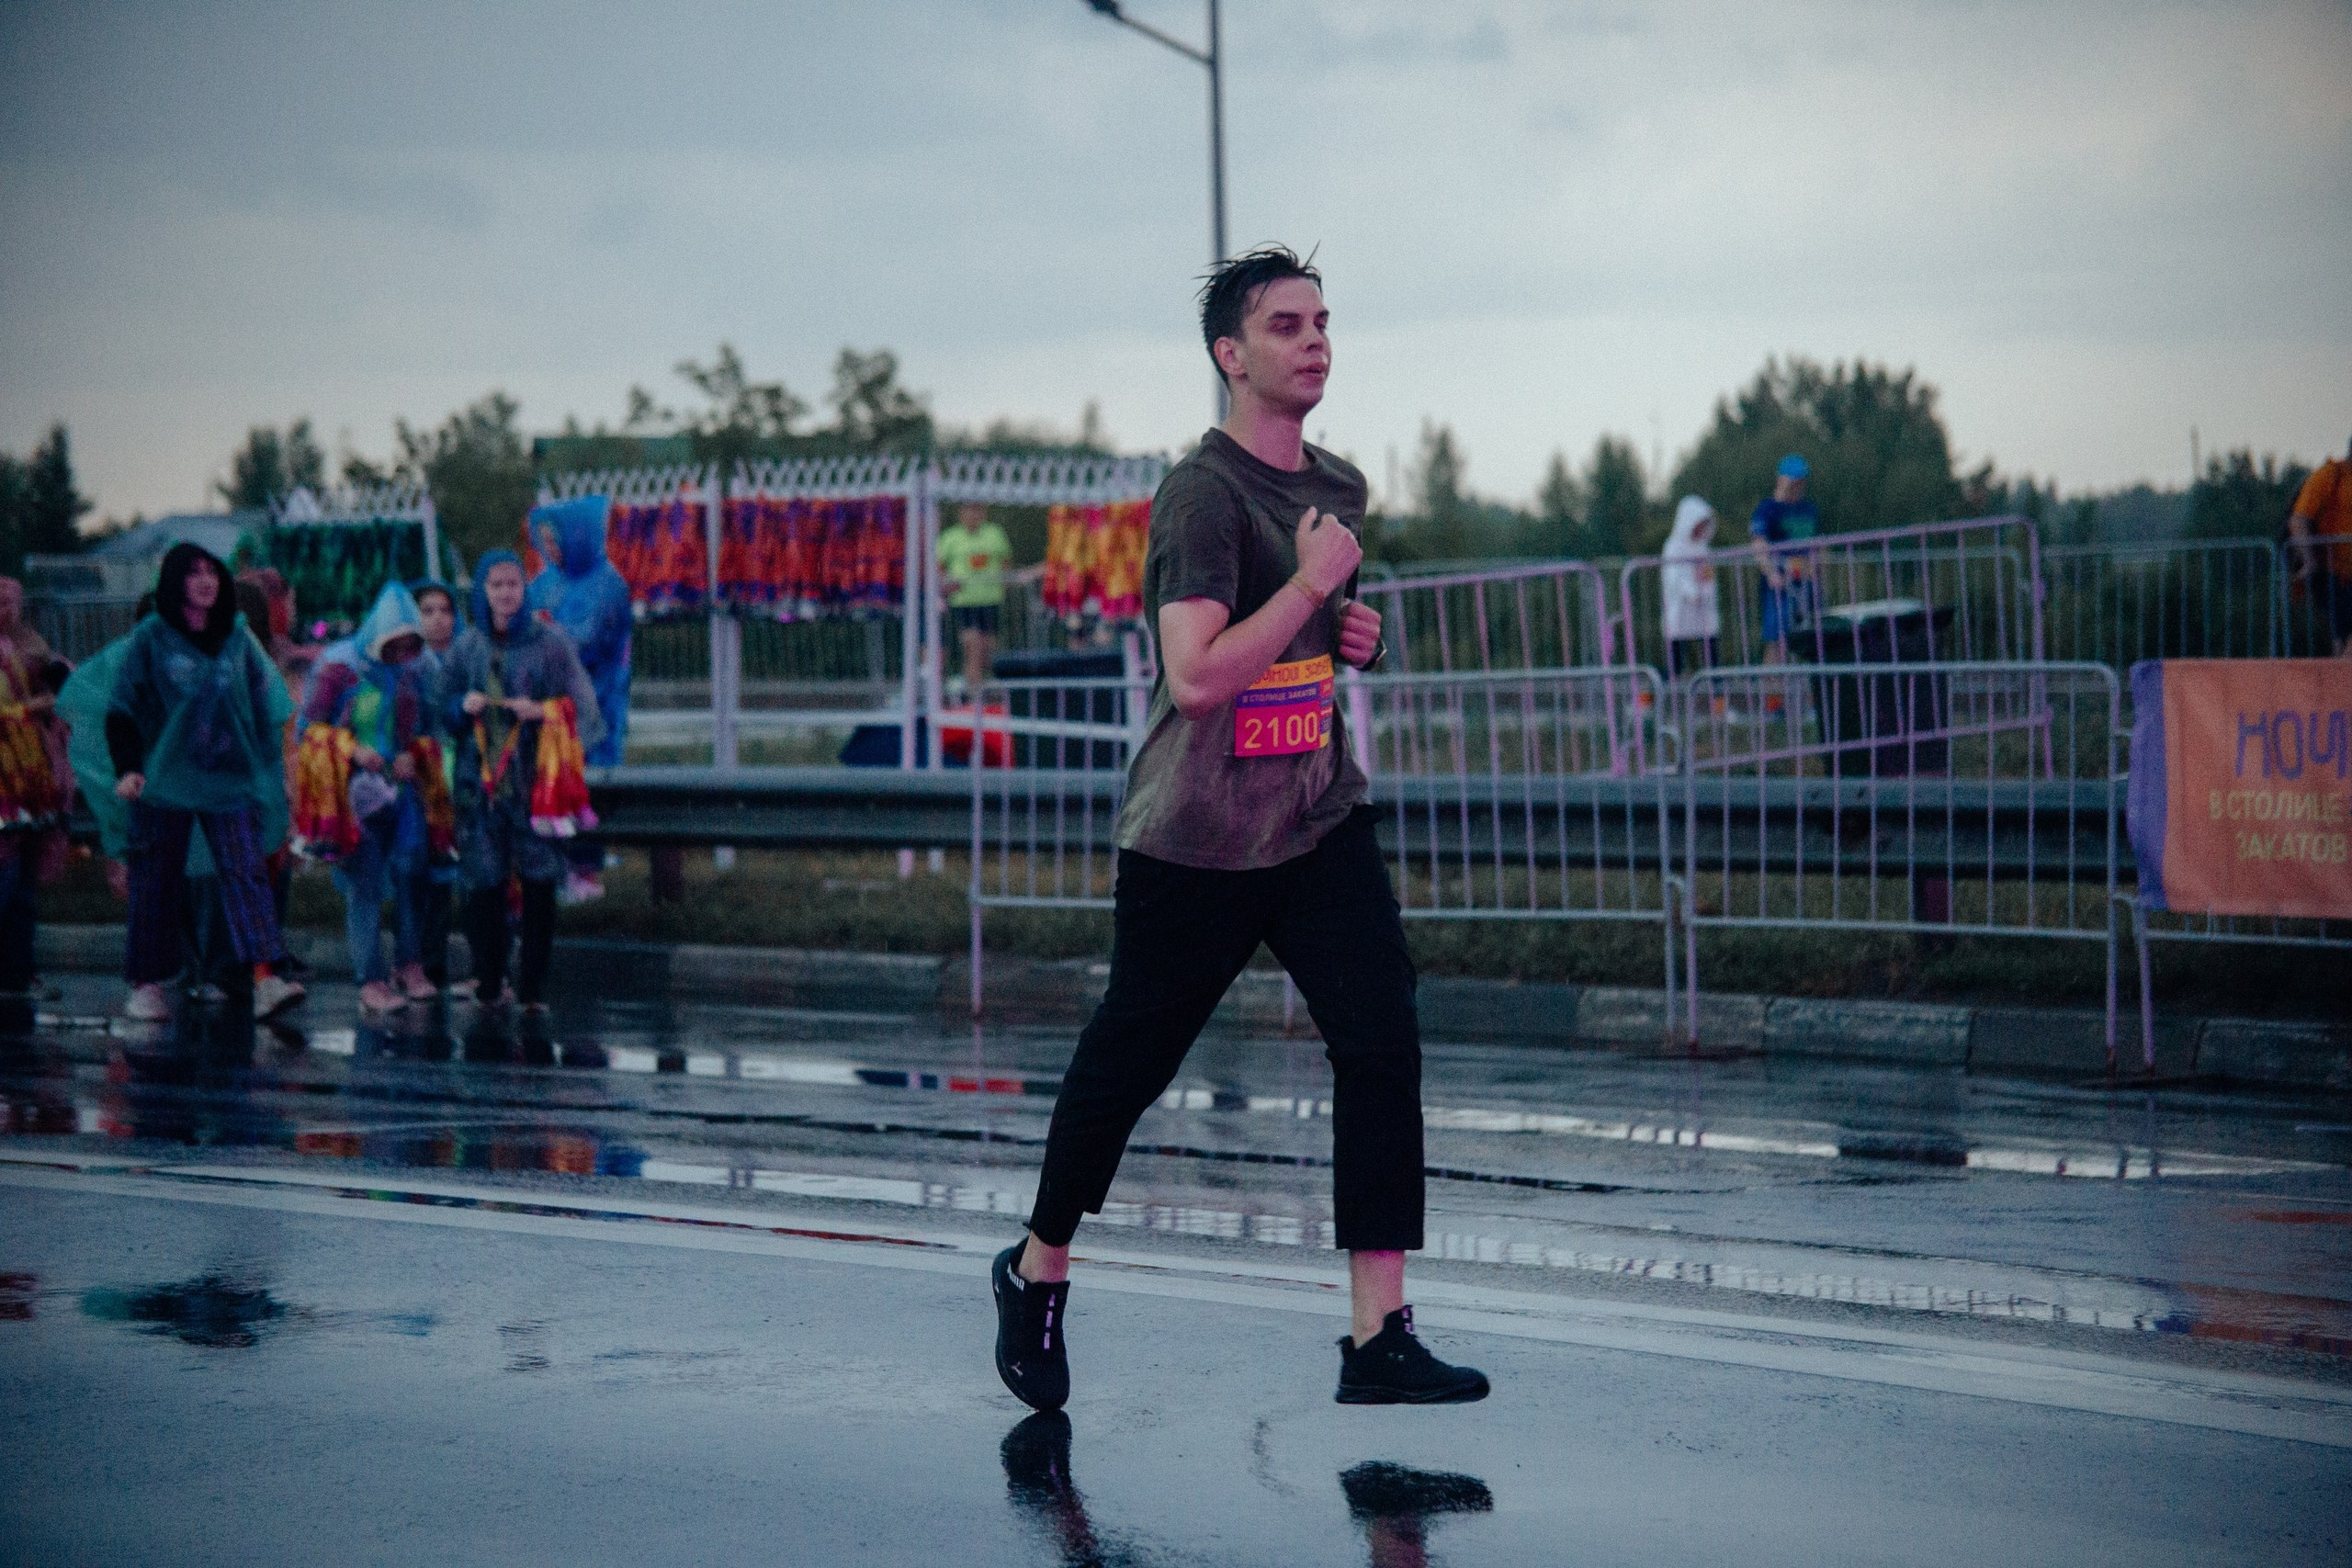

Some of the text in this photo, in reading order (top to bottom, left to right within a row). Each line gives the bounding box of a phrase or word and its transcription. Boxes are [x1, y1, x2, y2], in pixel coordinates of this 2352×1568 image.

[1244, 711, 1318, 749] 2100
[2208, 789, 2344, 822] В СТОЛИЦЕ
[2234, 830, 2349, 863] ЗАКАТОВ
